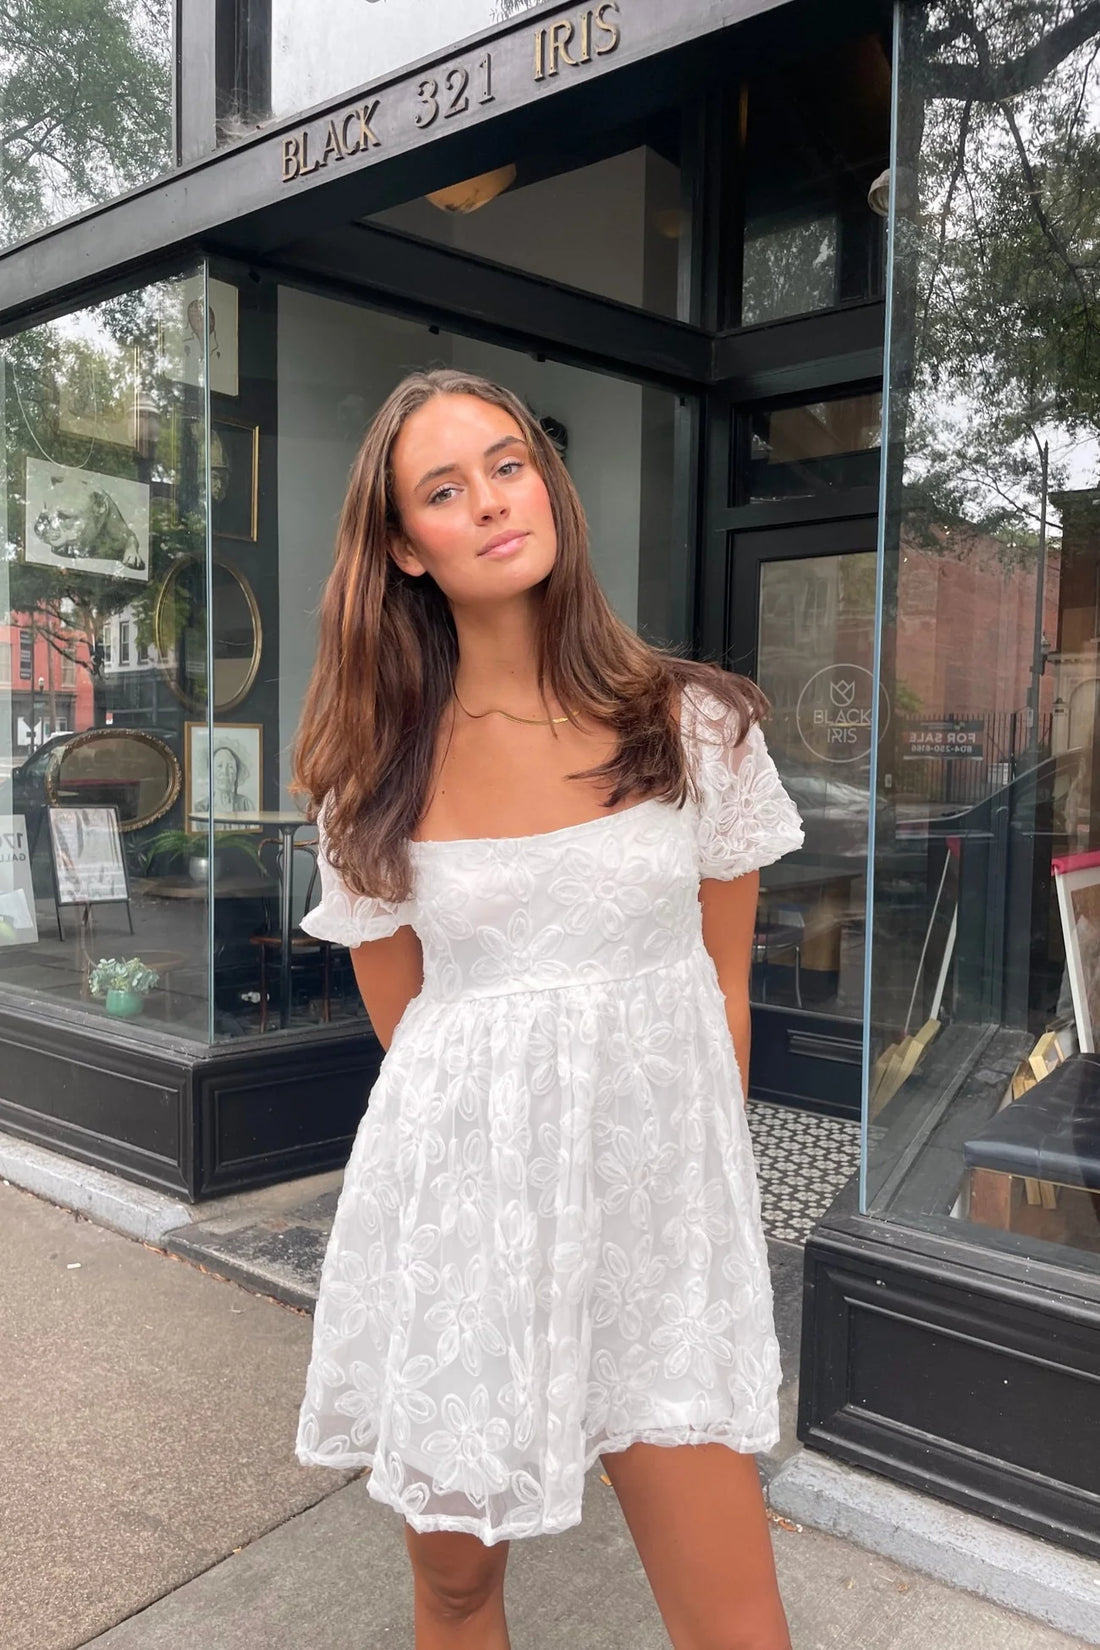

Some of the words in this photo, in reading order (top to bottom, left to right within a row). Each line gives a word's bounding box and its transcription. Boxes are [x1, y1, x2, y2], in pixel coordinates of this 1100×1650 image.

[282, 100, 380, 182] BLACK
[415, 53, 495, 128] 321
[534, 2, 621, 81] IRIS
[814, 708, 872, 724] BLACK
[827, 728, 858, 743] IRIS
